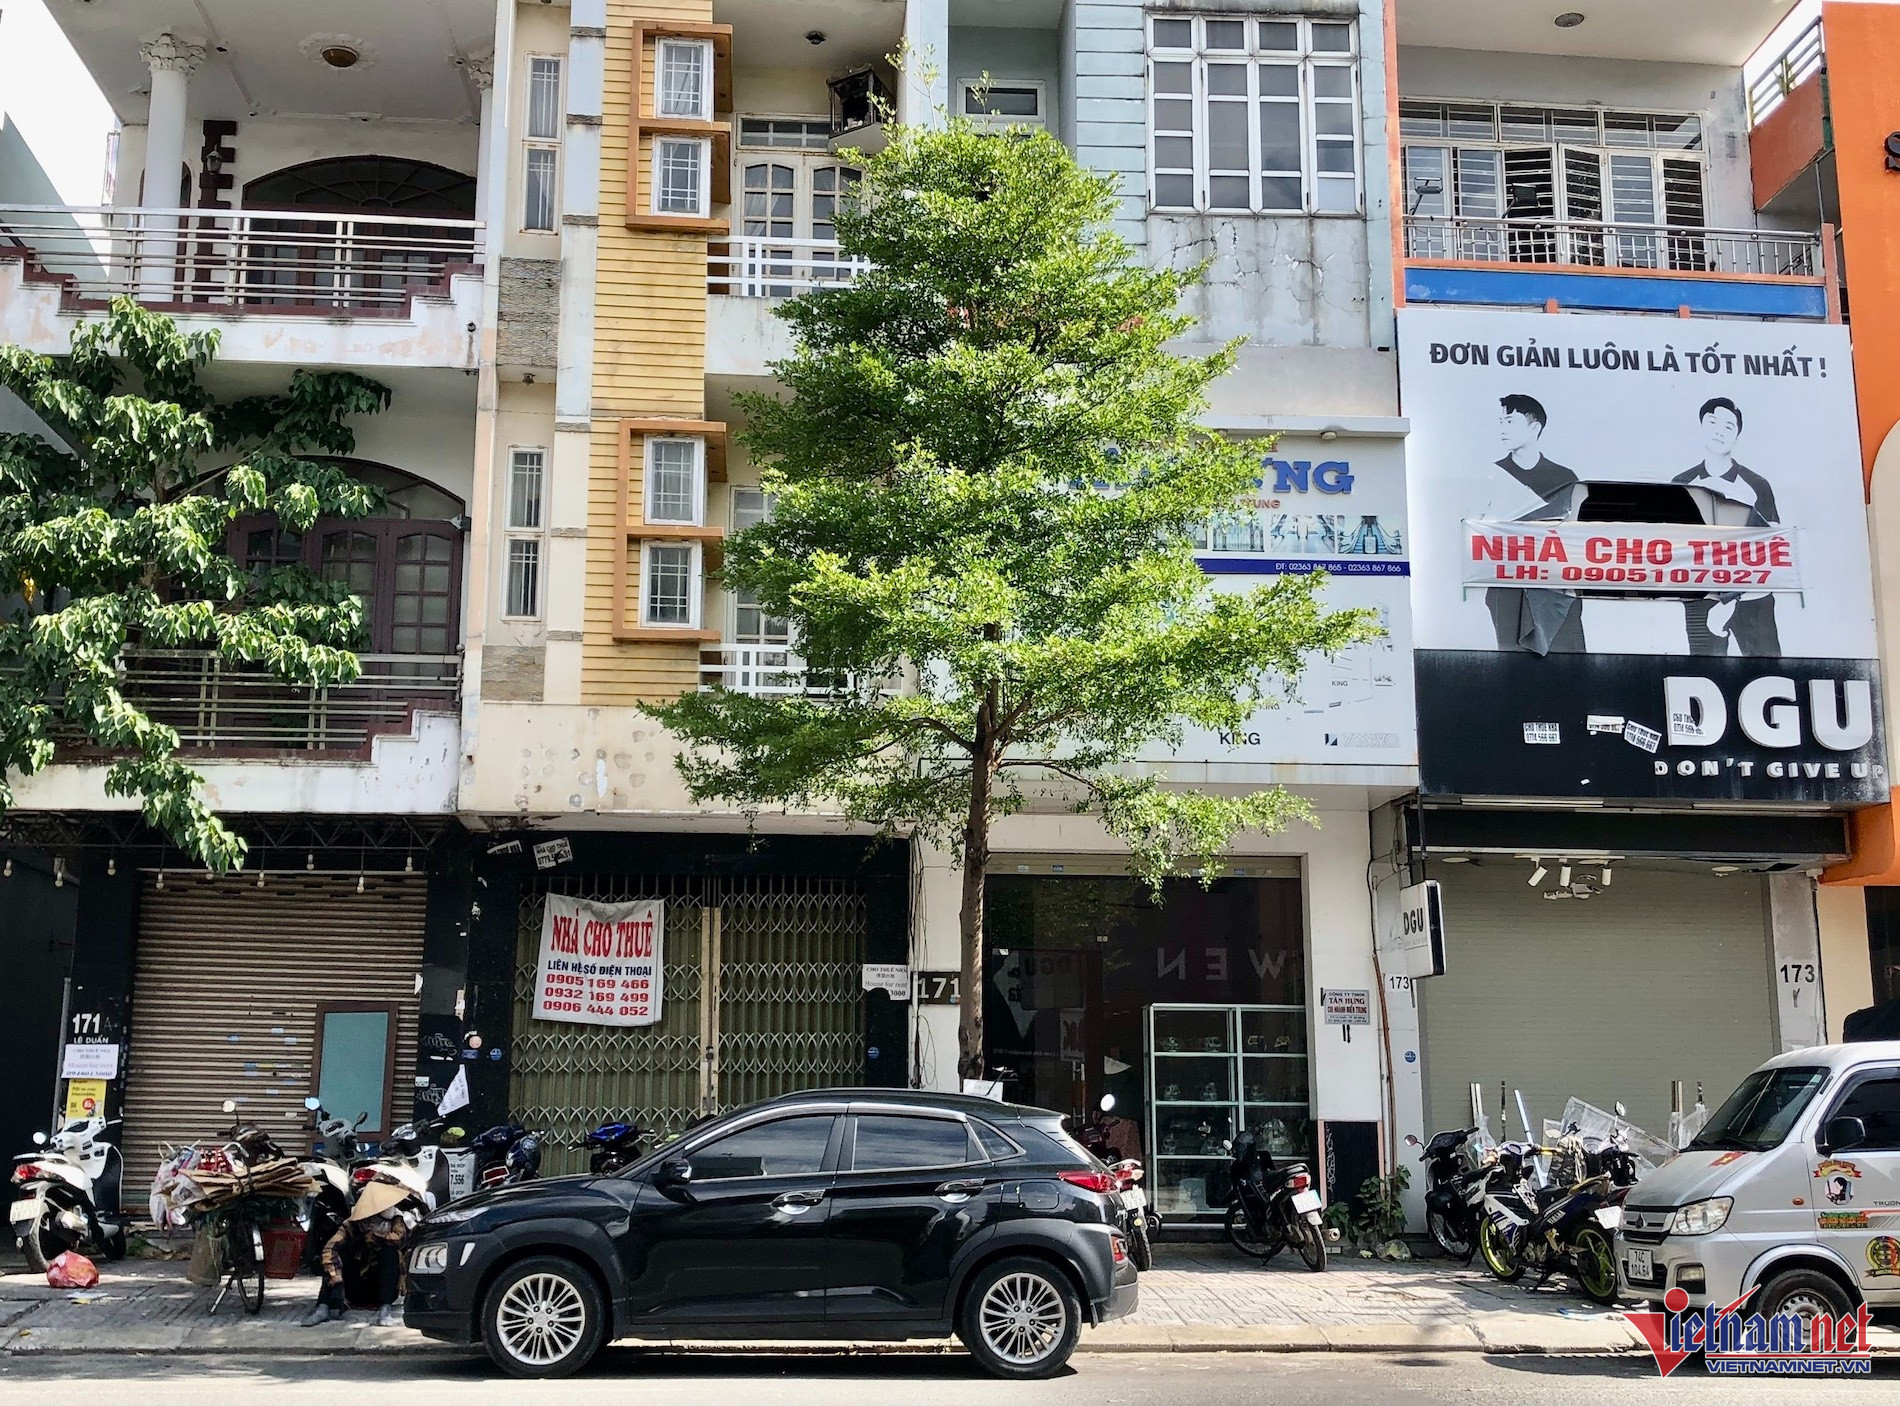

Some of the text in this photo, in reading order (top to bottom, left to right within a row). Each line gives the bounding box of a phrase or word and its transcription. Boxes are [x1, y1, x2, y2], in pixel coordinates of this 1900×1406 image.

[1429, 342, 1489, 365] ĐƠN
[1496, 337, 1560, 368] GIẢN
[1567, 341, 1640, 370] LUÔN
[1647, 344, 1680, 372] LÀ
[1685, 341, 1737, 374] TỐT
[1743, 345, 1812, 377] NHẤT
[1471, 529, 1792, 567] NHÀ CHO THUÊ
[1288, 562, 1312, 571] 02363
[1327, 563, 1342, 571] 865
[1347, 563, 1370, 572] 02363
[1371, 564, 1385, 572] 867
[1387, 565, 1401, 573] 866
[1495, 564, 1772, 584] LH: 0905107927
[1663, 676, 1873, 751] DGU
[1654, 758, 1884, 779] DON'T GIVE UP
[1403, 907, 1424, 935] DGU
[583, 920, 612, 958] CHO
[616, 910, 653, 958] THUÊ
[547, 959, 569, 971] LIÊN
[584, 962, 597, 975] SỐ
[599, 964, 622, 978] ĐIỆN
[625, 966, 652, 978] THOẠI
[1780, 964, 1815, 983] 173
[546, 973, 649, 989] 0905 169 466
[1389, 976, 1410, 990] 173
[544, 987, 649, 1003] 0932 169 499
[543, 1000, 649, 1016] 0906 444 052
[72, 1013, 101, 1034] 171
